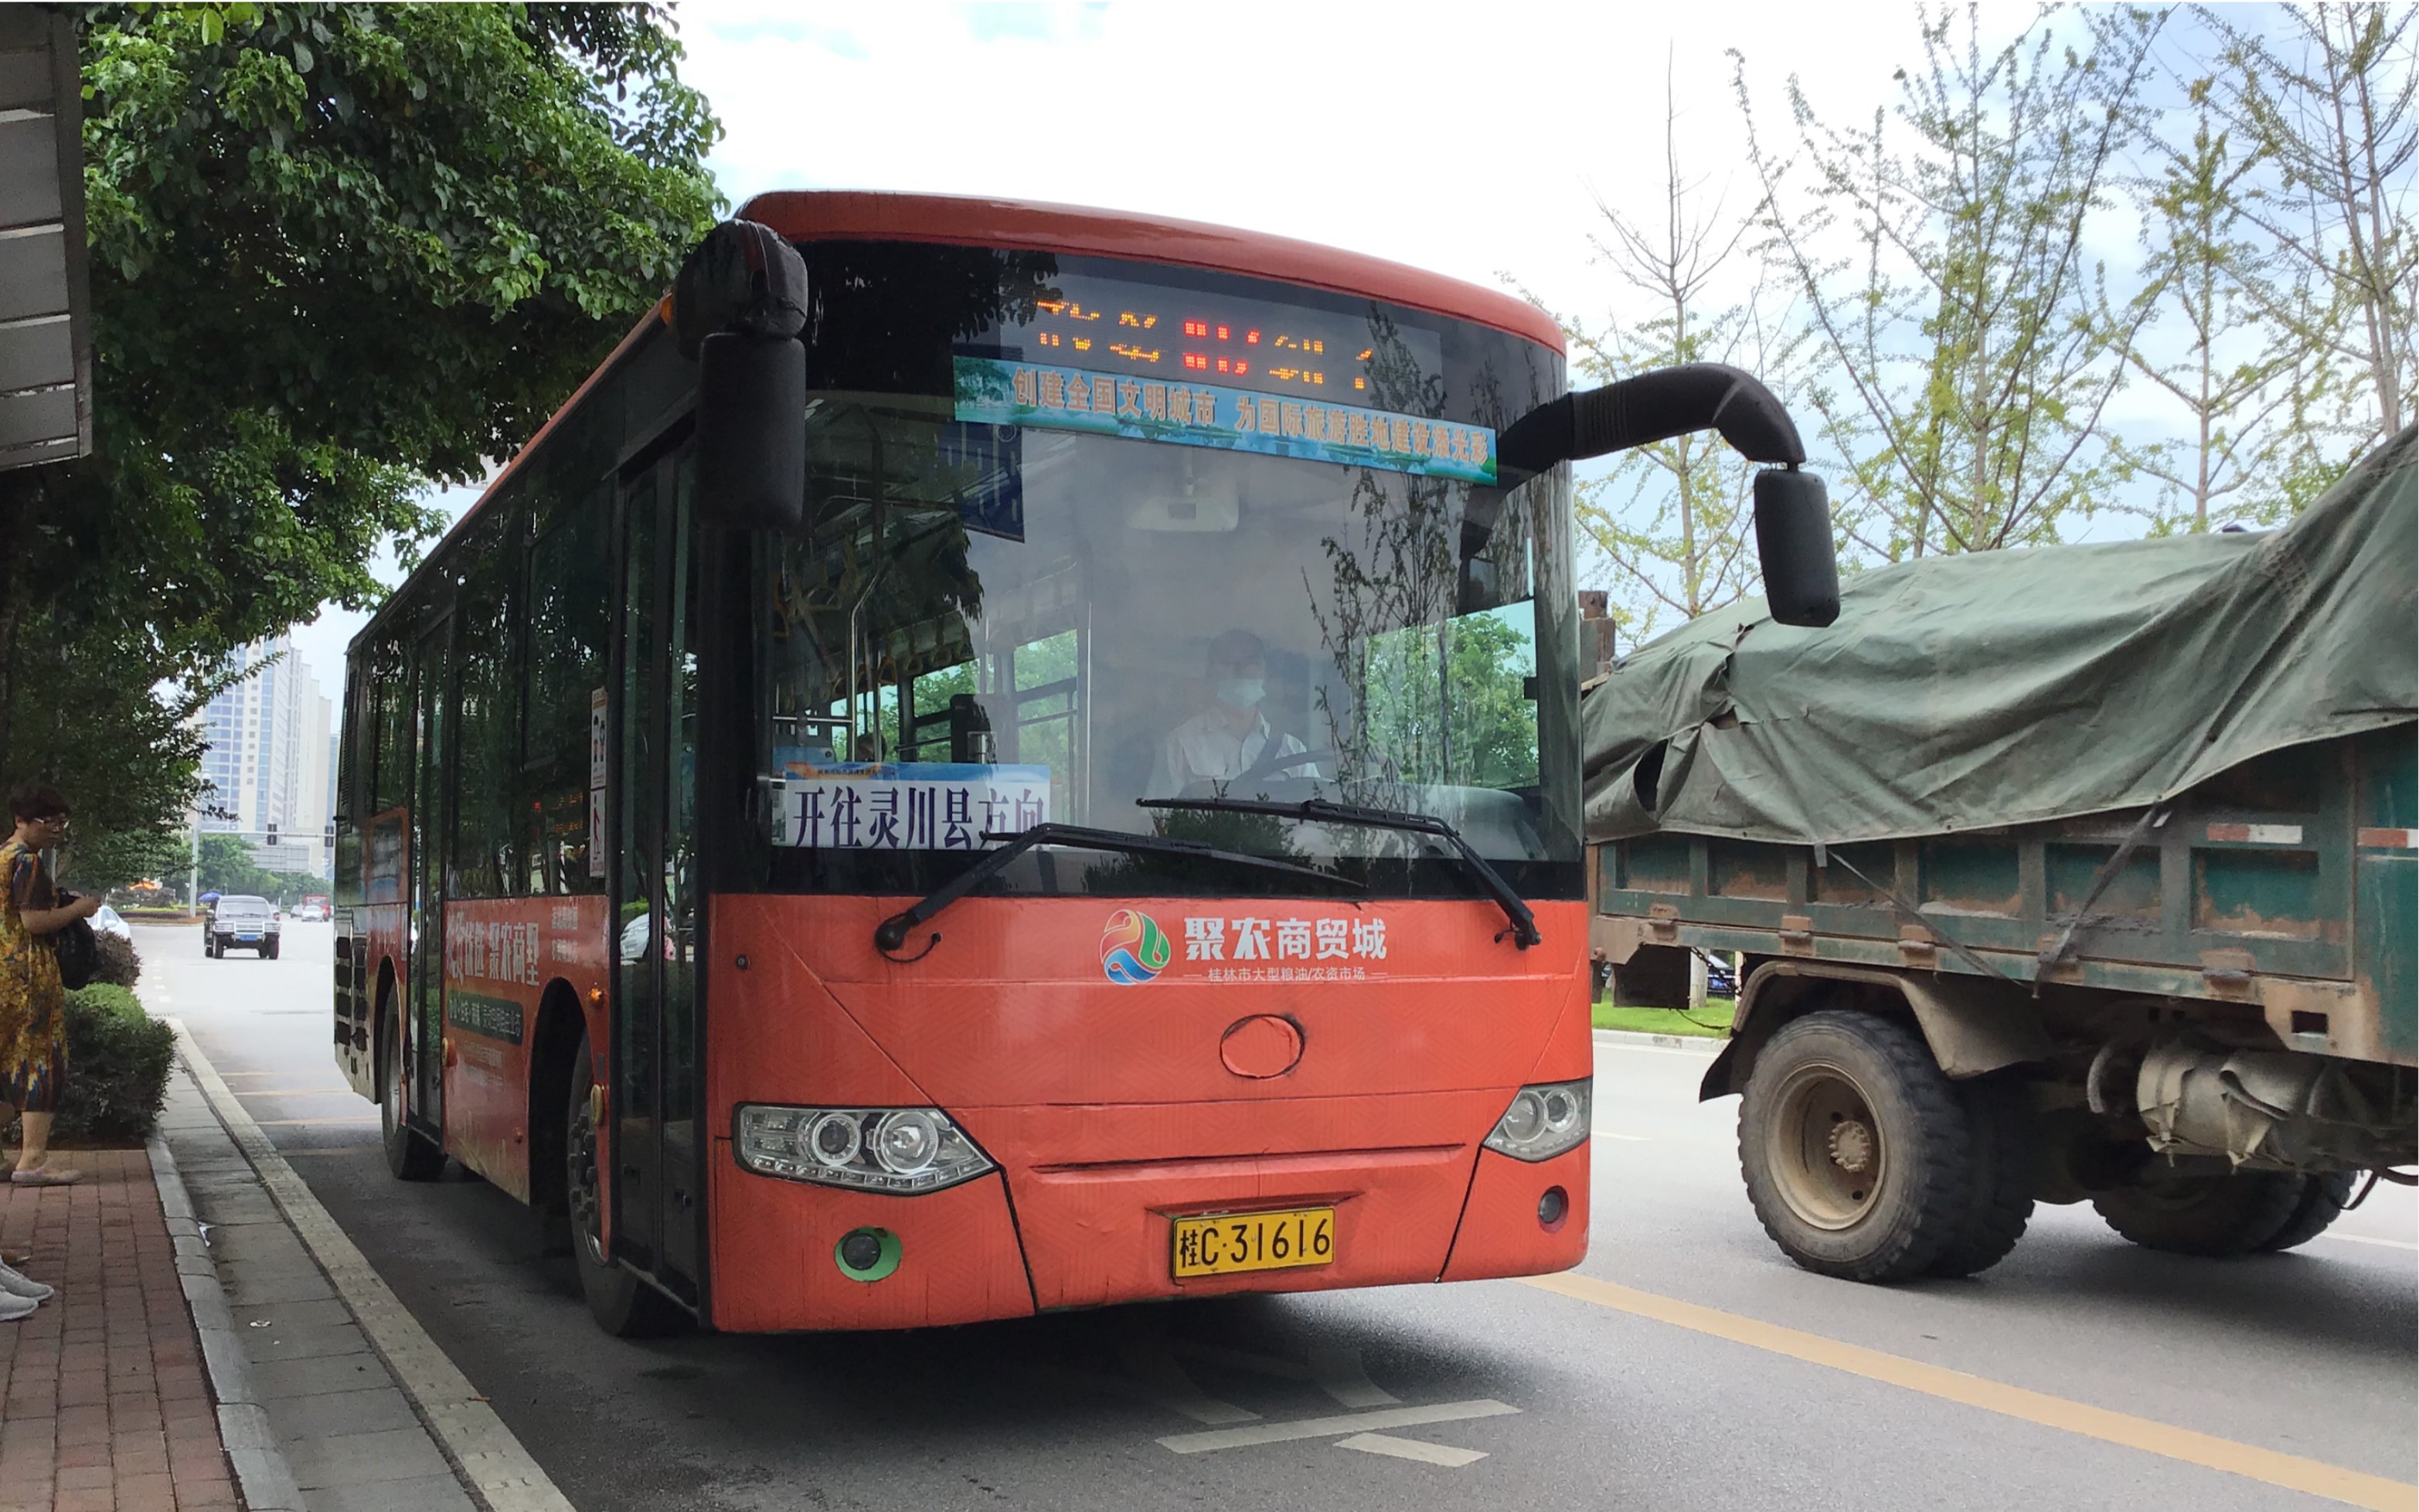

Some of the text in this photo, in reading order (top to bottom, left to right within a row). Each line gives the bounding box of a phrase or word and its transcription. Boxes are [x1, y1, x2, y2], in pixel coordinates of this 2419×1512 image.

[1012, 365, 1489, 465] 创建全国文明城市 为国际旅游胜地建设添光彩
[793, 786, 1045, 850] 开往灵川县方向
[1183, 917, 1387, 960] 聚农商贸城
[1208, 967, 1366, 982] 桂林市大型粮油/农资市场
